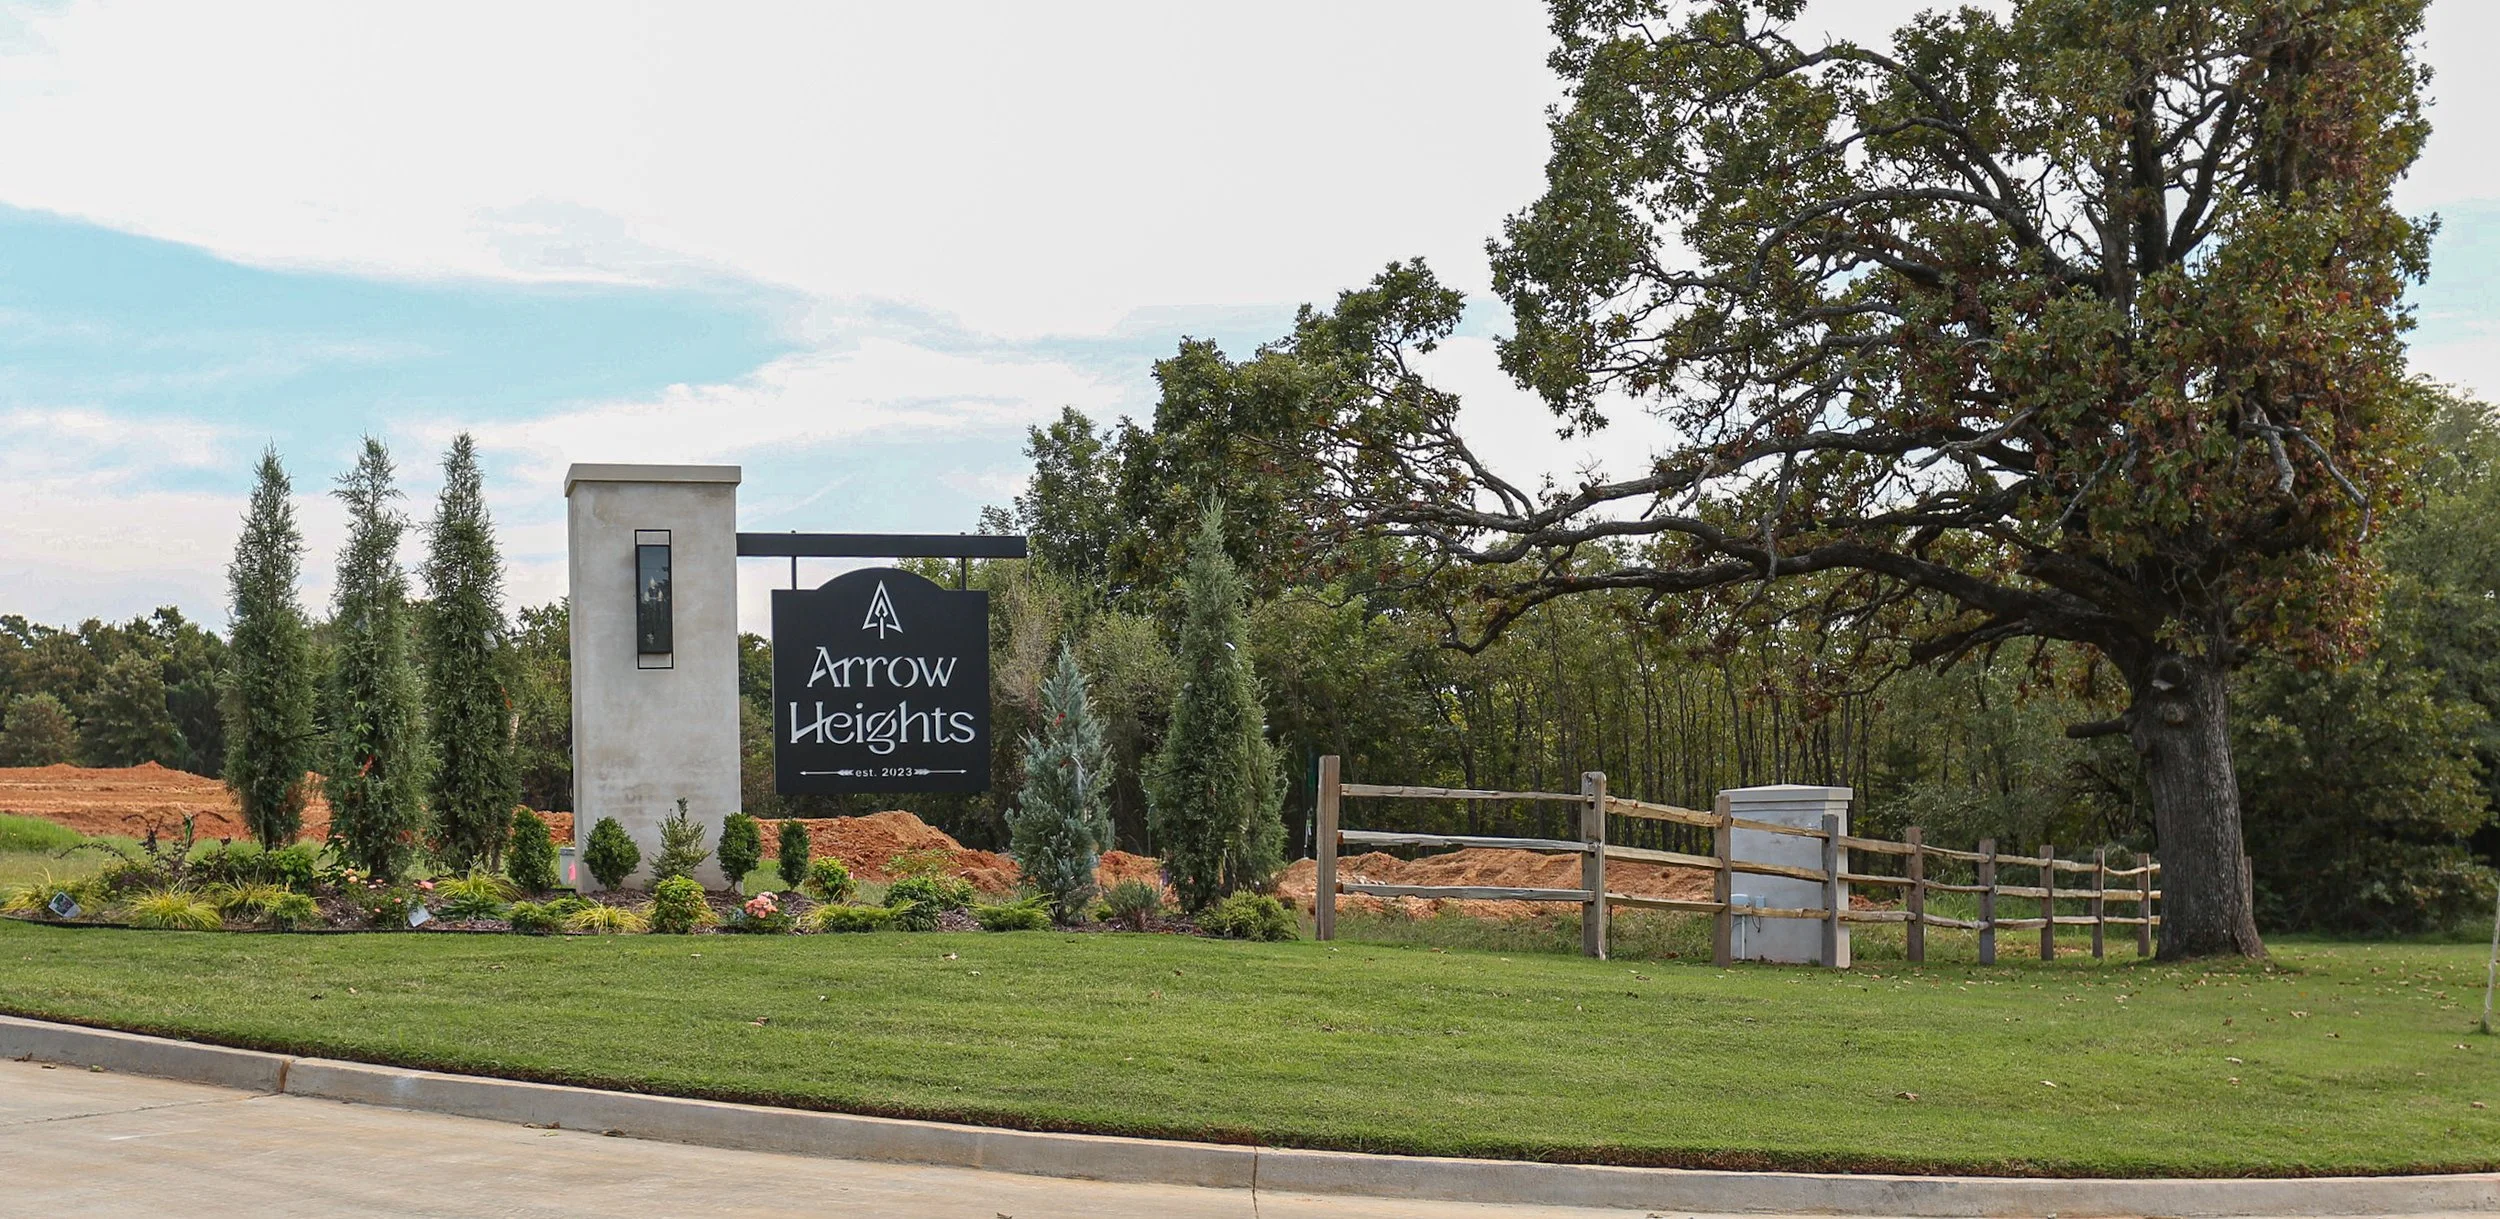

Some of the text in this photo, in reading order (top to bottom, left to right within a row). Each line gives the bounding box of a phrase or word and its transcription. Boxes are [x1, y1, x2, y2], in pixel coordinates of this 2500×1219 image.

[806, 646, 958, 689] Arrow
[789, 700, 976, 755] Heights
[855, 767, 913, 778] est. 2023
